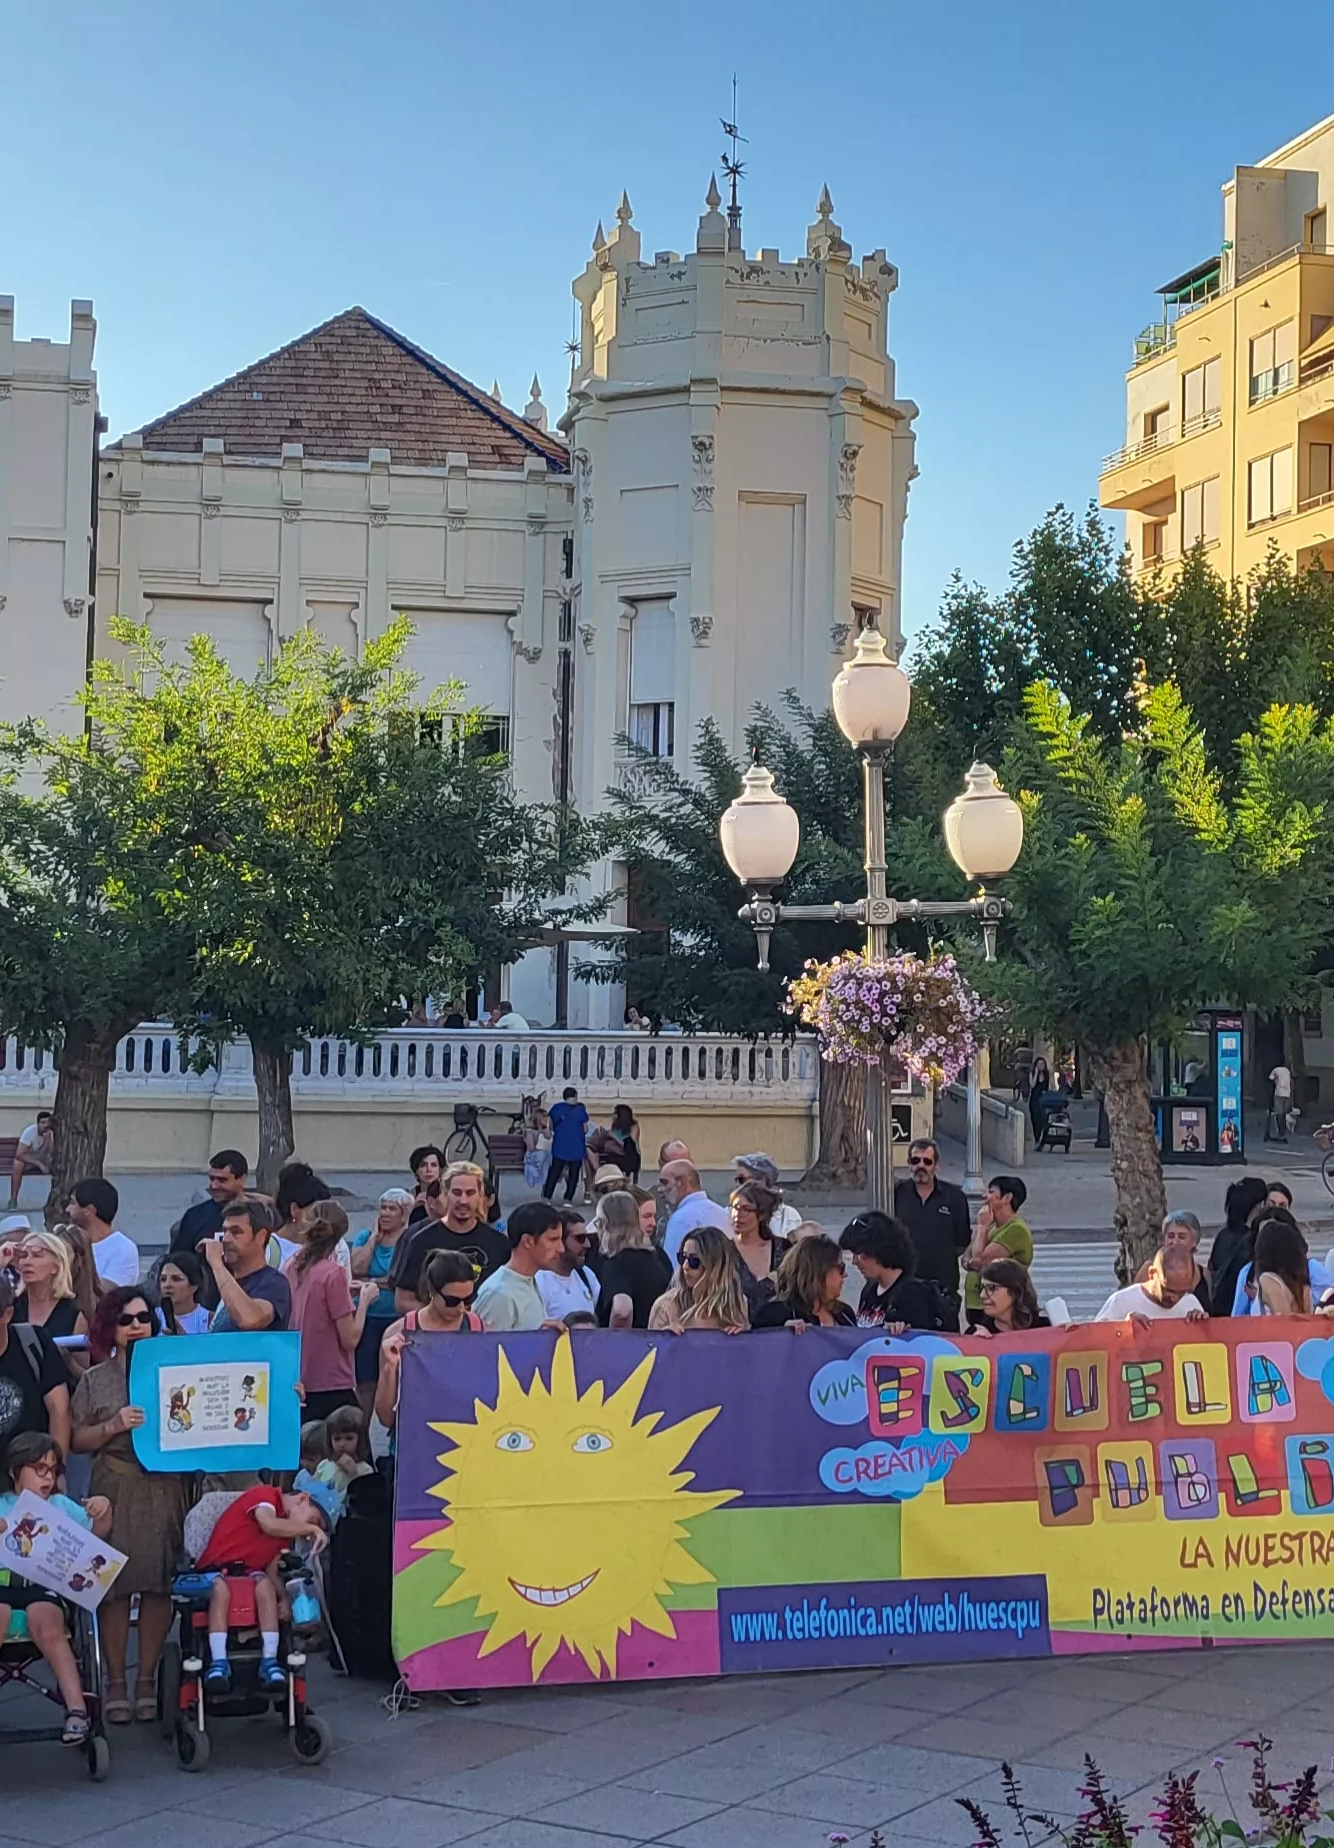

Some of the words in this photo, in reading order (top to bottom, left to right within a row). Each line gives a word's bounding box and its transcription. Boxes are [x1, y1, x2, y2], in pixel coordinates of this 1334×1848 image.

[817, 1371, 866, 1406] VIVA
[874, 1354, 1292, 1429] ESCUELA
[834, 1438, 963, 1484] CREATIVA
[1179, 1535, 1214, 1570] LA
[730, 1591, 1040, 1643] www.telefonica.net/web/huescpu
[1092, 1586, 1210, 1630] Plataforma
[1221, 1591, 1246, 1623] en
